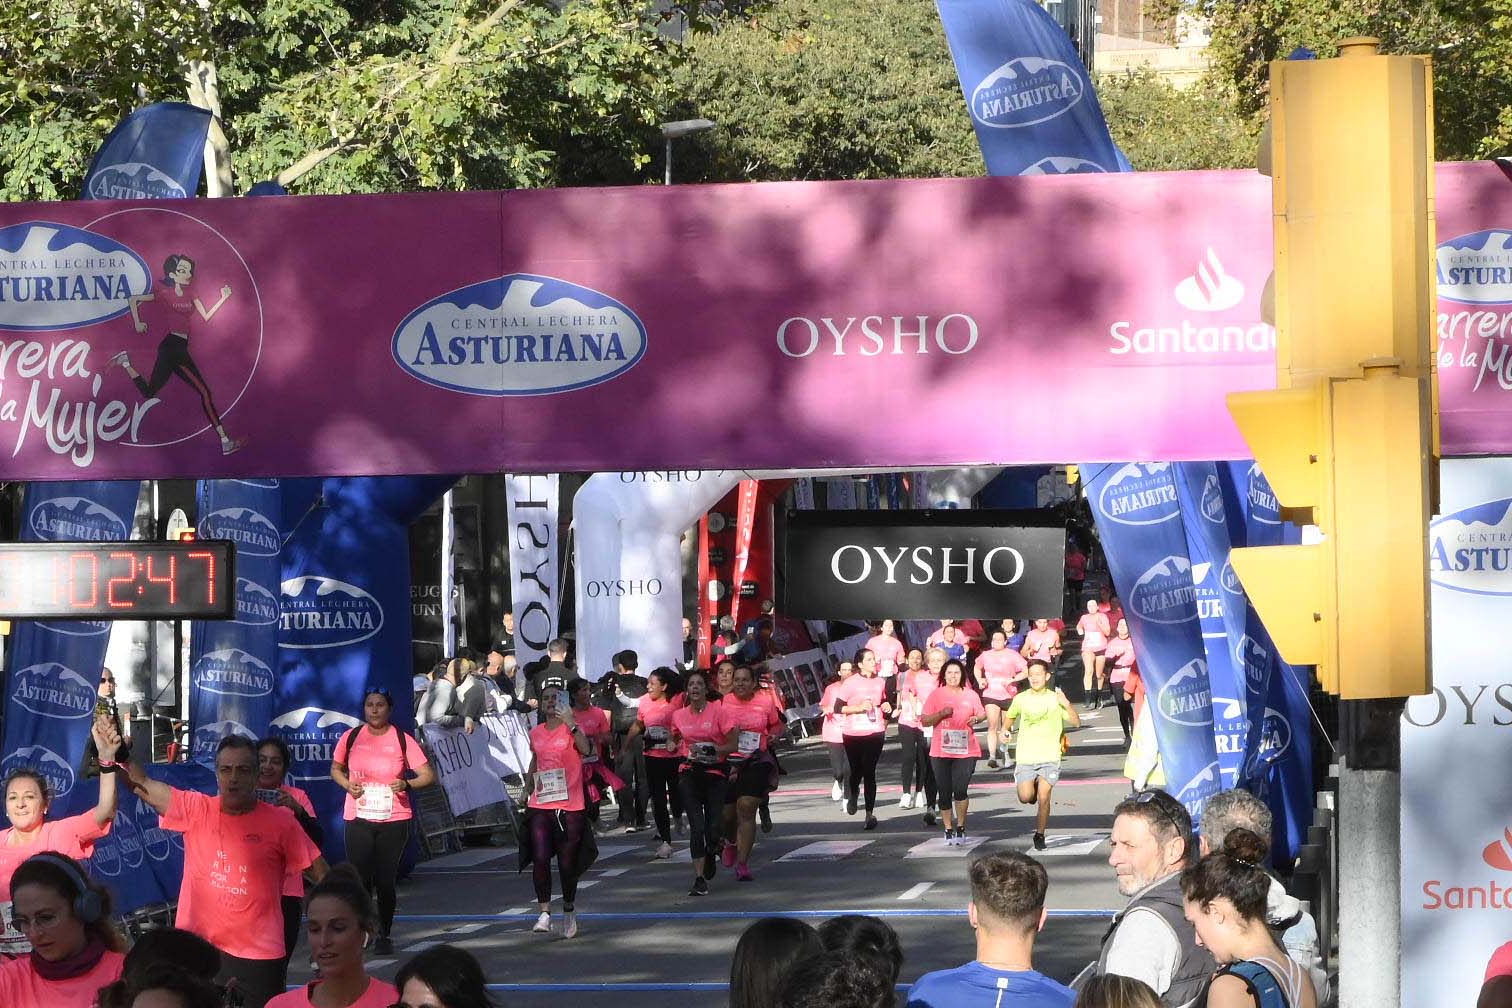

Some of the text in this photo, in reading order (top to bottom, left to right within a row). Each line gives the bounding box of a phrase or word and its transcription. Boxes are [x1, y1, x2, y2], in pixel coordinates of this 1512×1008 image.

[54, 256, 127, 271] LECHERA
[1450, 255, 1503, 264] CENTRAL
[451, 315, 619, 330] CENTRAL LECHERA
[776, 313, 978, 358] OYSHO
[1110, 320, 1277, 355] Santand
[1437, 310, 1512, 340] arrer
[411, 321, 627, 367] ASTURIANA
[1460, 339, 1478, 368] la
[12, 372, 161, 468] Mujer
[831, 545, 1025, 586] OYSHO
[1430, 536, 1512, 572] ASTU
[587, 578, 662, 598] OYSHO
[279, 611, 375, 631] TURIANA
[197, 667, 270, 691] ASTURIANA
[15, 679, 90, 711] ASTURIANA
